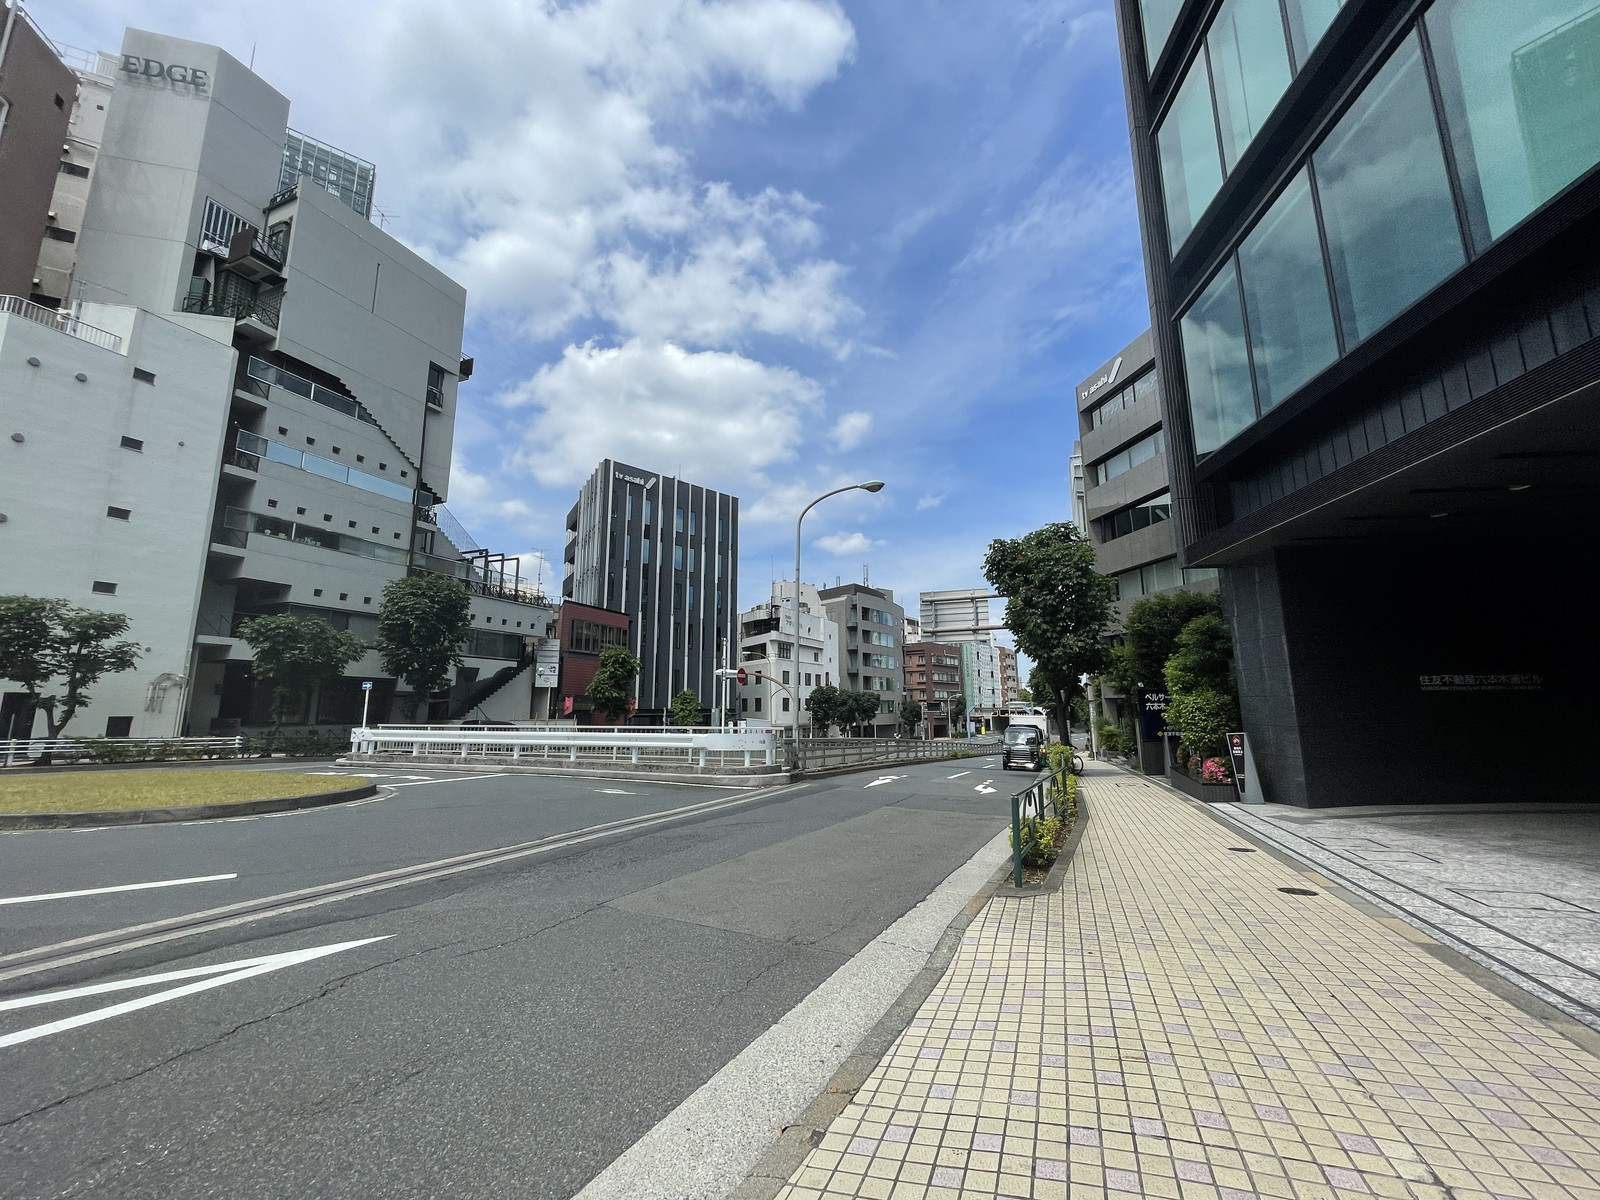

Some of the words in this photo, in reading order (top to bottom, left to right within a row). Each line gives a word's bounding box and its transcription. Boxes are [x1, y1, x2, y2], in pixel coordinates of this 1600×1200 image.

[119, 54, 208, 87] EDGE
[1081, 390, 1089, 400] tv
[1089, 374, 1108, 394] asahi
[624, 475, 645, 486] asahi
